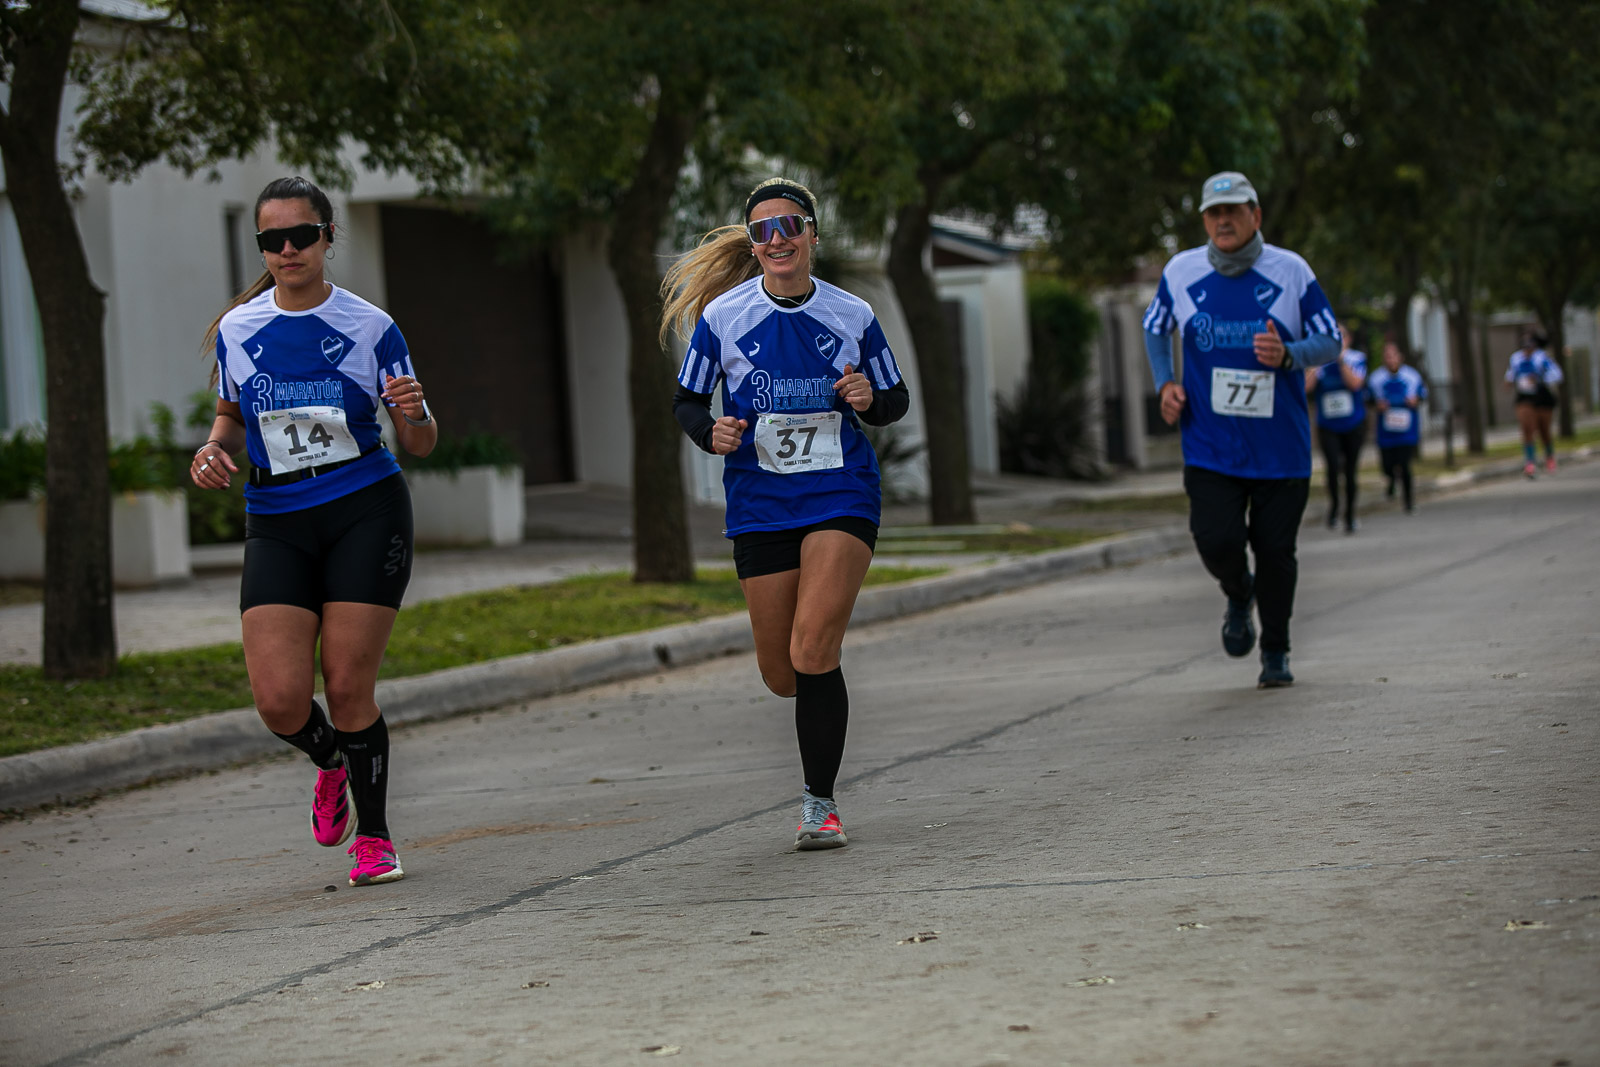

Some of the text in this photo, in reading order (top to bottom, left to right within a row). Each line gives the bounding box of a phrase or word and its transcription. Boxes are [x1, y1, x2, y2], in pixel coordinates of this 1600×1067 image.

[1191, 311, 1214, 353] 3
[1214, 318, 1266, 336] MARATÓ
[252, 373, 343, 416] 3 MARATÓN
[751, 369, 836, 414] 3 MARATÓN
[1227, 382, 1257, 405] 77
[283, 422, 335, 456] 14
[775, 426, 818, 459] 37
